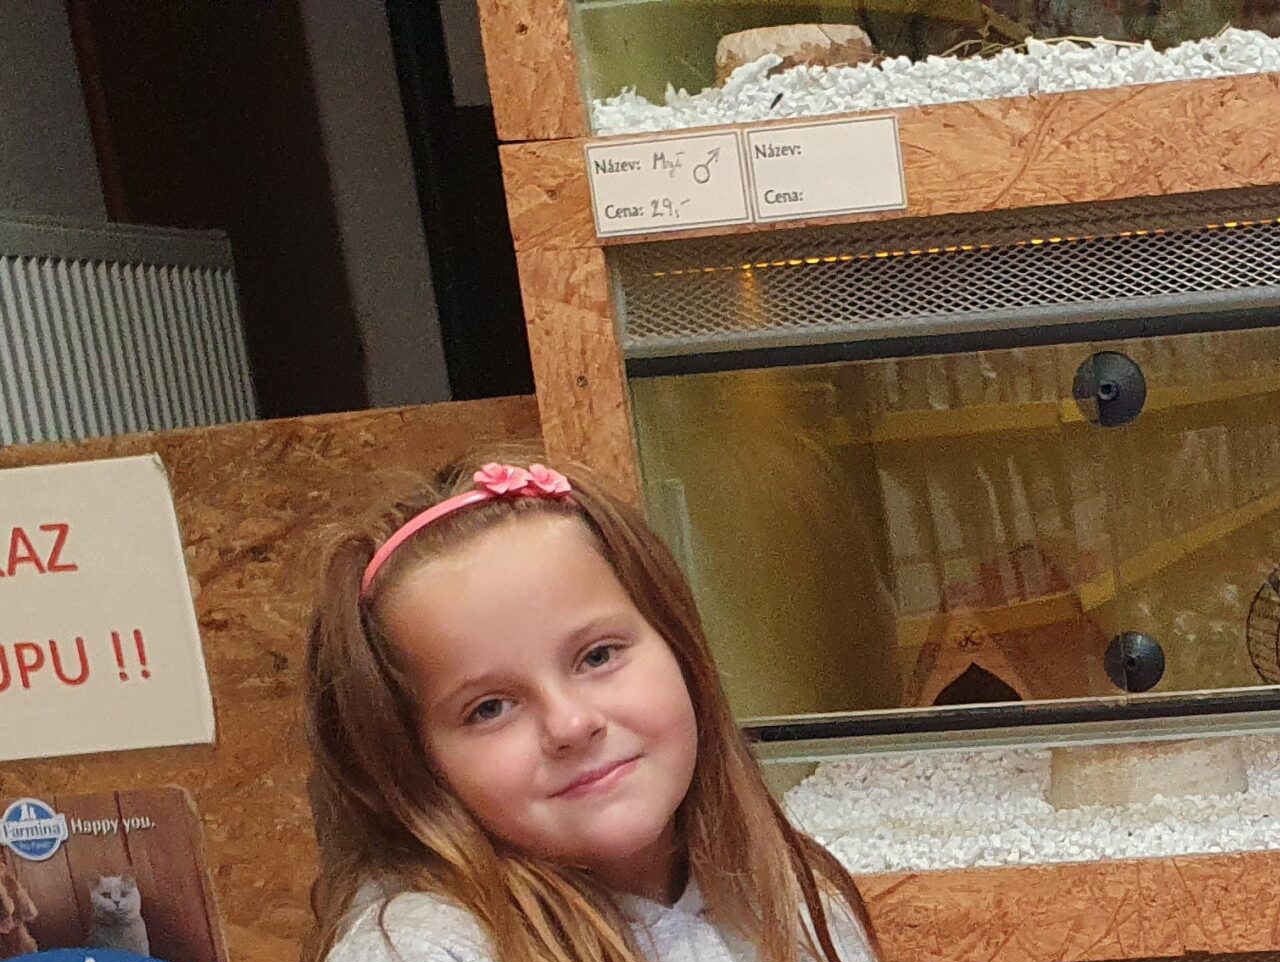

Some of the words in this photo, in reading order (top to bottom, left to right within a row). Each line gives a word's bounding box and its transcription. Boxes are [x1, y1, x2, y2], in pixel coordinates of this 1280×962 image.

[755, 142, 802, 159] Název:
[594, 159, 642, 175] Název:
[764, 189, 804, 204] Cena:
[605, 204, 644, 219] Cena:
[0, 523, 78, 577] AZ
[71, 817, 119, 836] Happy
